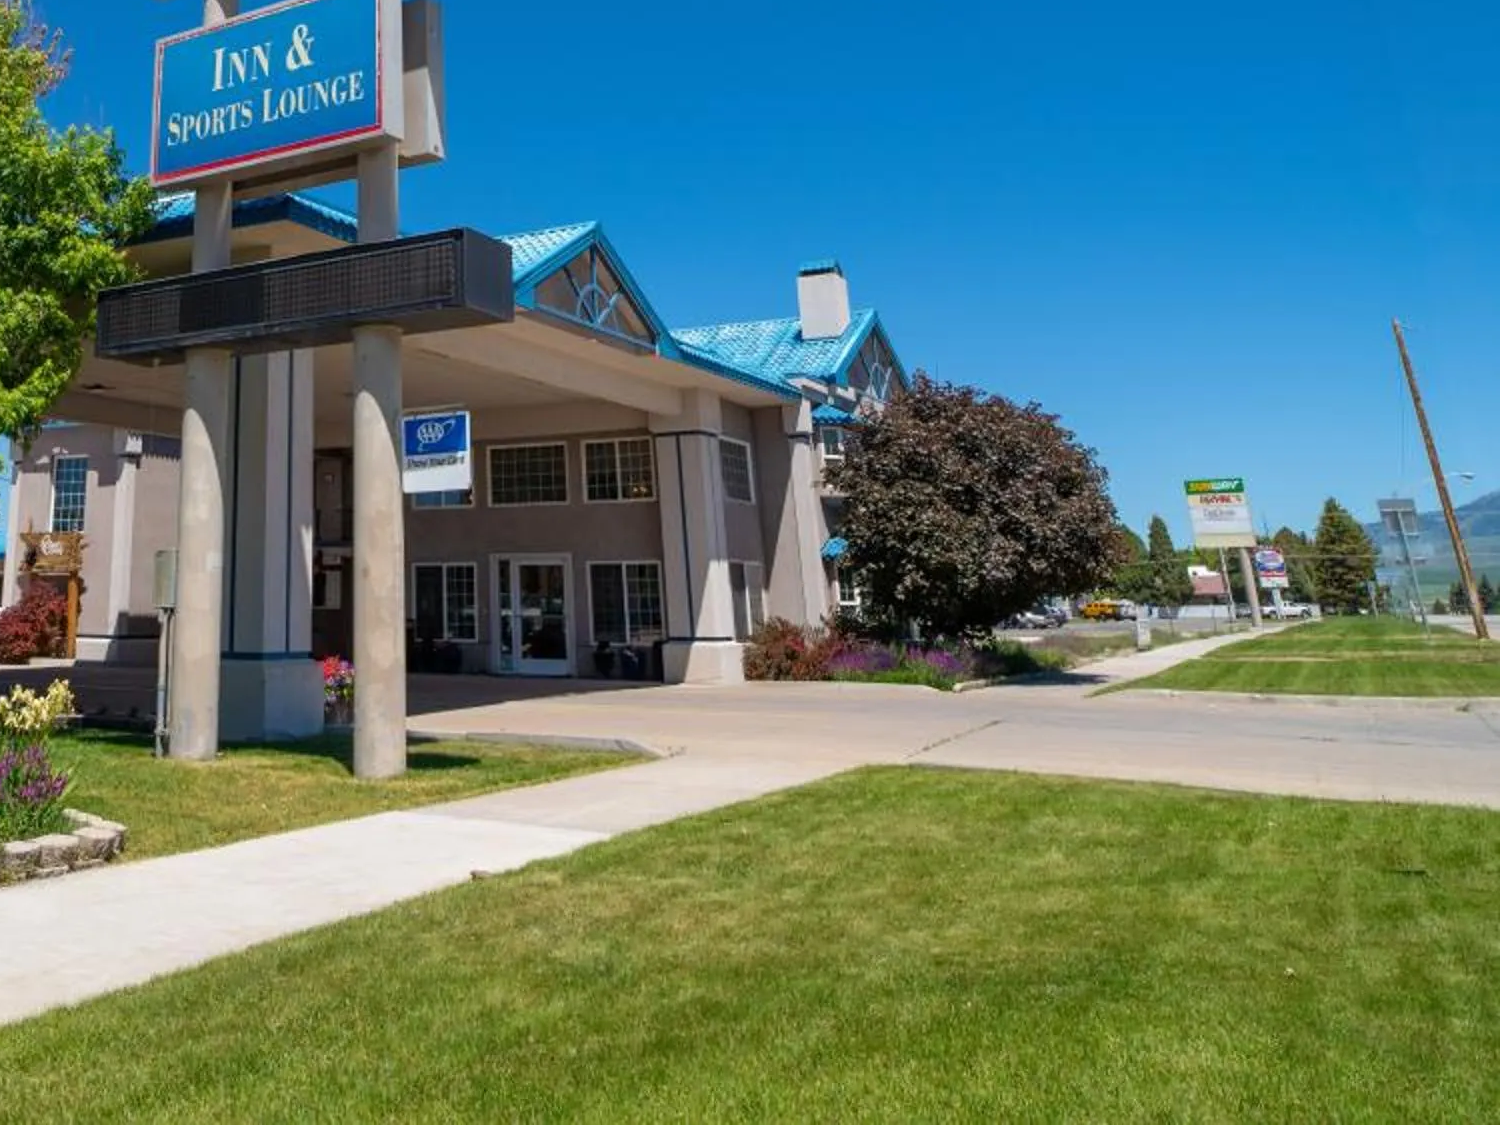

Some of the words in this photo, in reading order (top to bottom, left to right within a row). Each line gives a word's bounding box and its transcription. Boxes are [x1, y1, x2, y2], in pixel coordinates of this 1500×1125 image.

[211, 41, 273, 92] INN
[285, 23, 316, 72] &
[166, 100, 254, 147] SPORTS
[263, 70, 365, 124] LOUNGE
